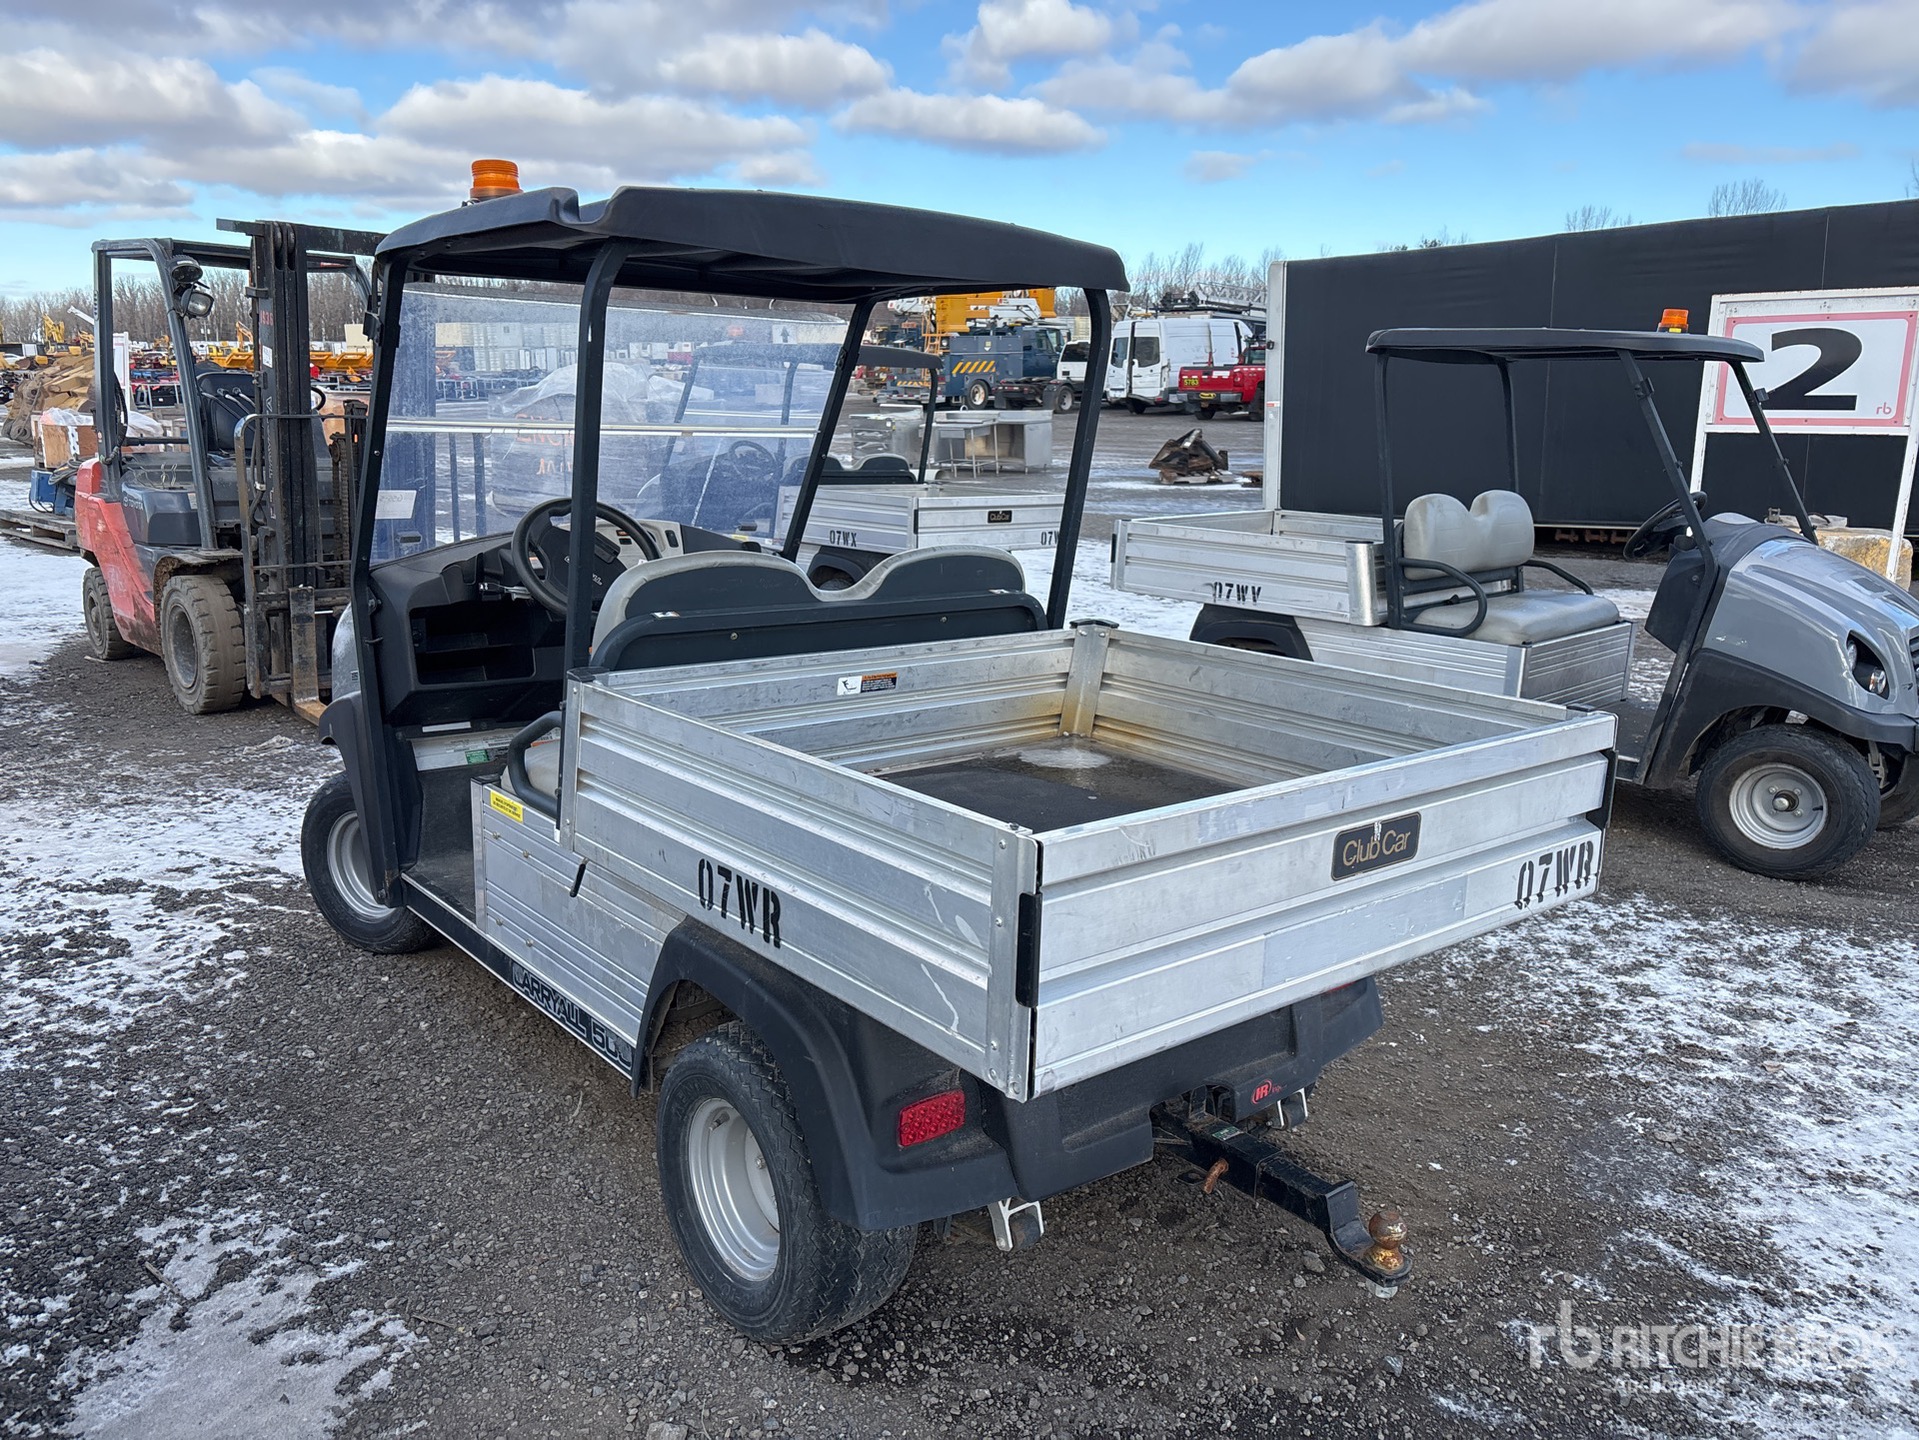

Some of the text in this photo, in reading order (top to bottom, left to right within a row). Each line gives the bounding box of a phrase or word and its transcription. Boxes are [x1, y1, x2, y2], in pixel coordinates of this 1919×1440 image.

[1761, 328, 1862, 410] 2
[1876, 403, 1892, 415] rb
[830, 530, 857, 548] 07WX
[1343, 829, 1411, 867] Club Car
[1515, 841, 1594, 910] 07WR
[699, 858, 781, 949] 07WR
